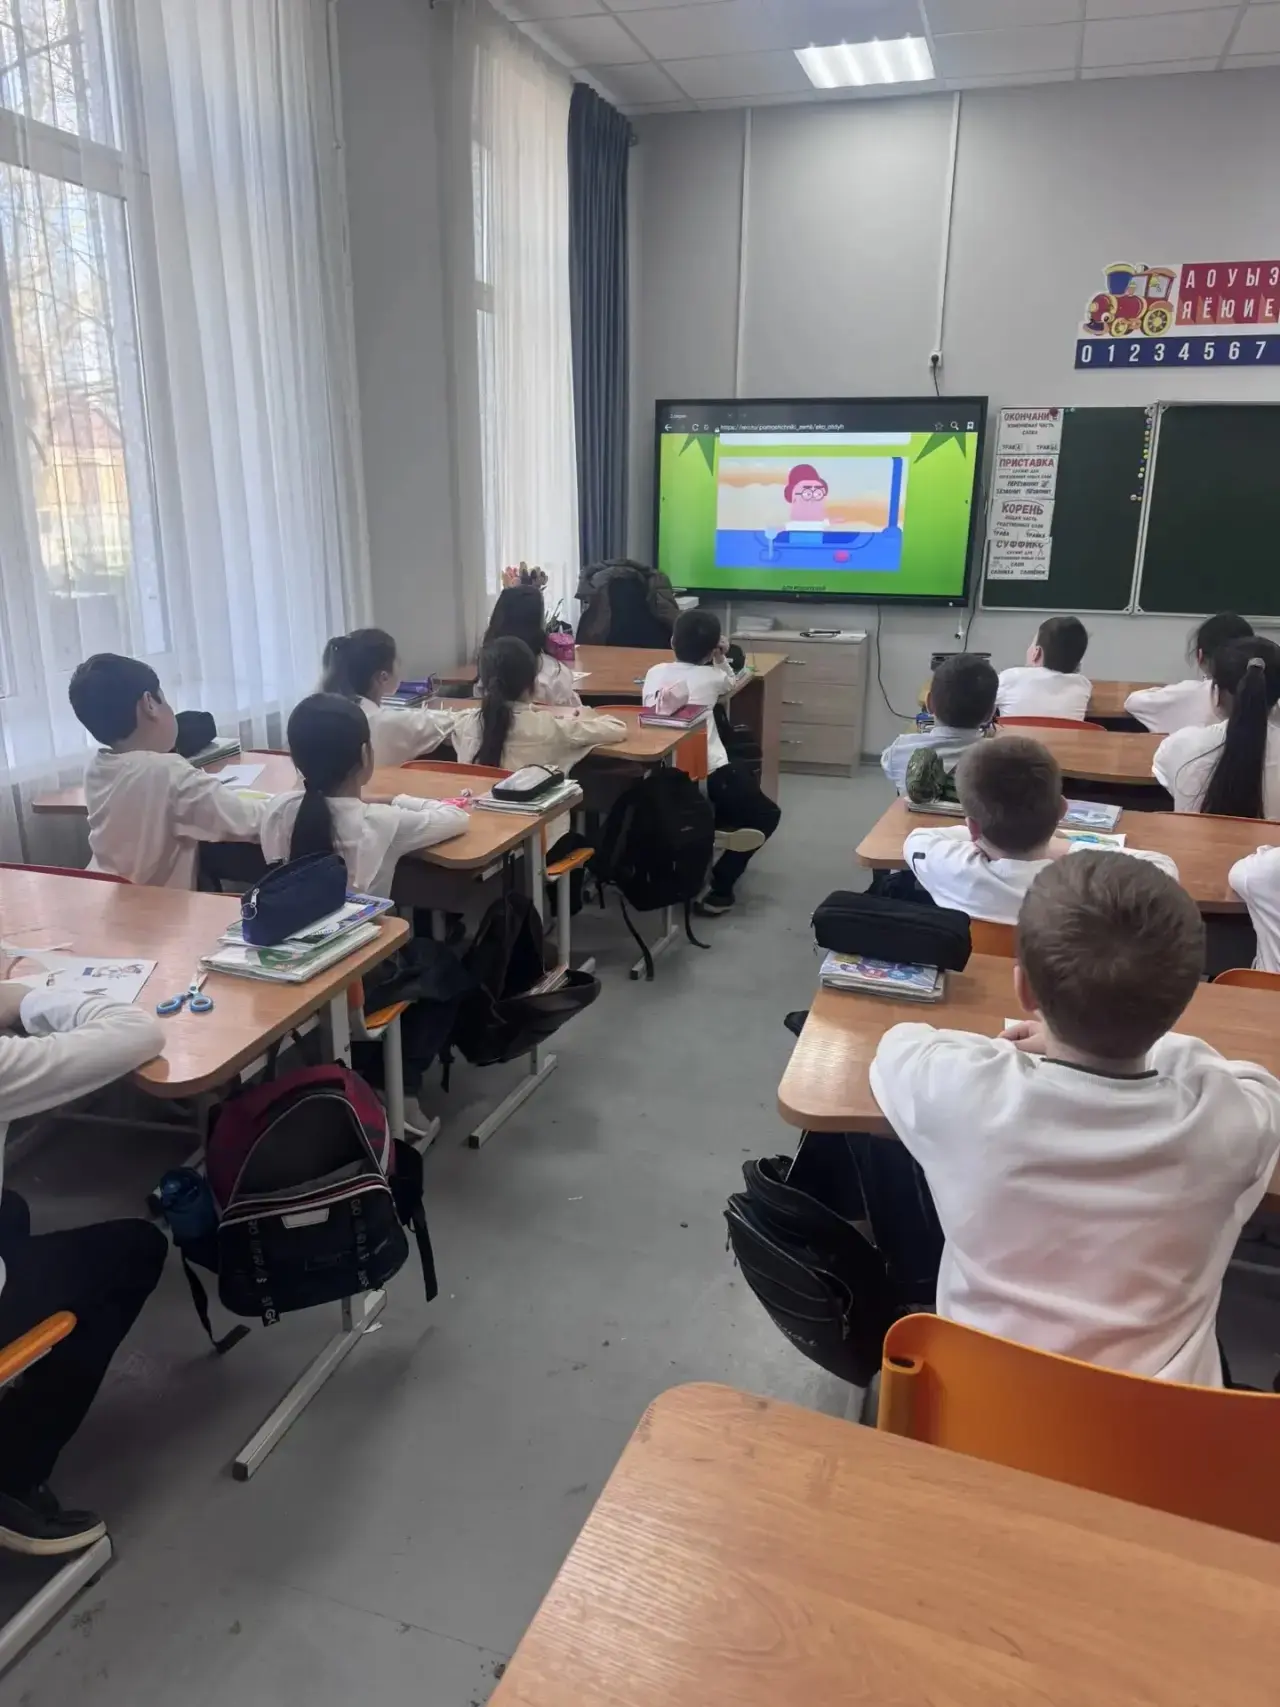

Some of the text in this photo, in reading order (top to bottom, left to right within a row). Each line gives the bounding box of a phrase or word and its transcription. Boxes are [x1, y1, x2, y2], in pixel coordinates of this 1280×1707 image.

[1185, 266, 1280, 288] А О У Ы Э
[1182, 297, 1275, 319] Я Ё Ю И Е
[1081, 341, 1267, 362] 0 1 2 3 4 5 6 7
[999, 459, 1054, 467] ПРИСТАВКА
[1002, 503, 1044, 515] КОРЕНЬ
